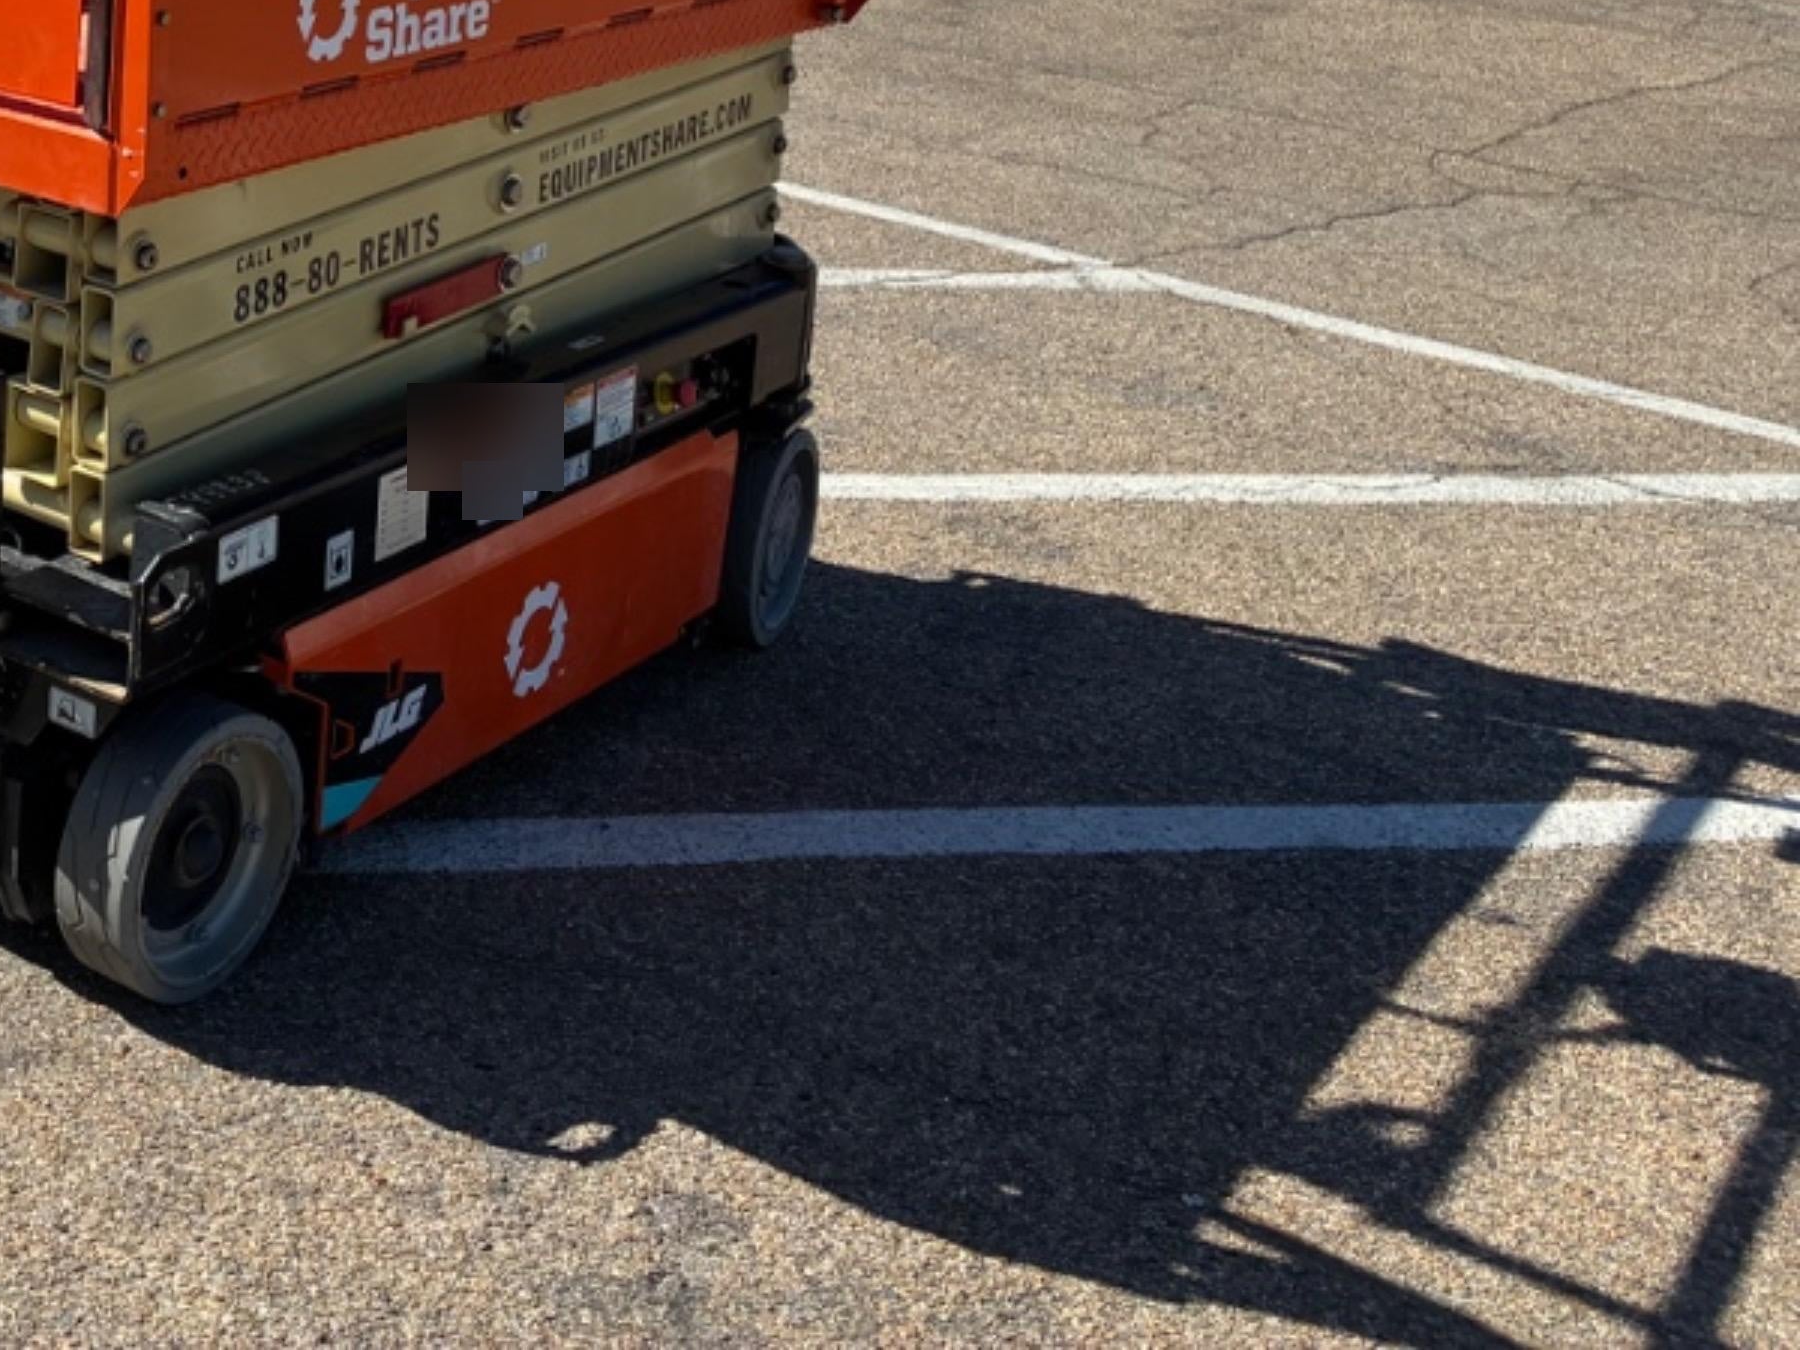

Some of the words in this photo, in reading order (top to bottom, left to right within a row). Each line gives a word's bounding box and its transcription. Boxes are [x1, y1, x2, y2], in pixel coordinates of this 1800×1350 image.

[538, 93, 753, 203] EQUIPMENTSHARE.COM
[234, 212, 440, 322] 888-80-RENTS
[236, 246, 273, 274] CALL
[281, 230, 313, 256] NOW
[359, 683, 427, 754] JLG
